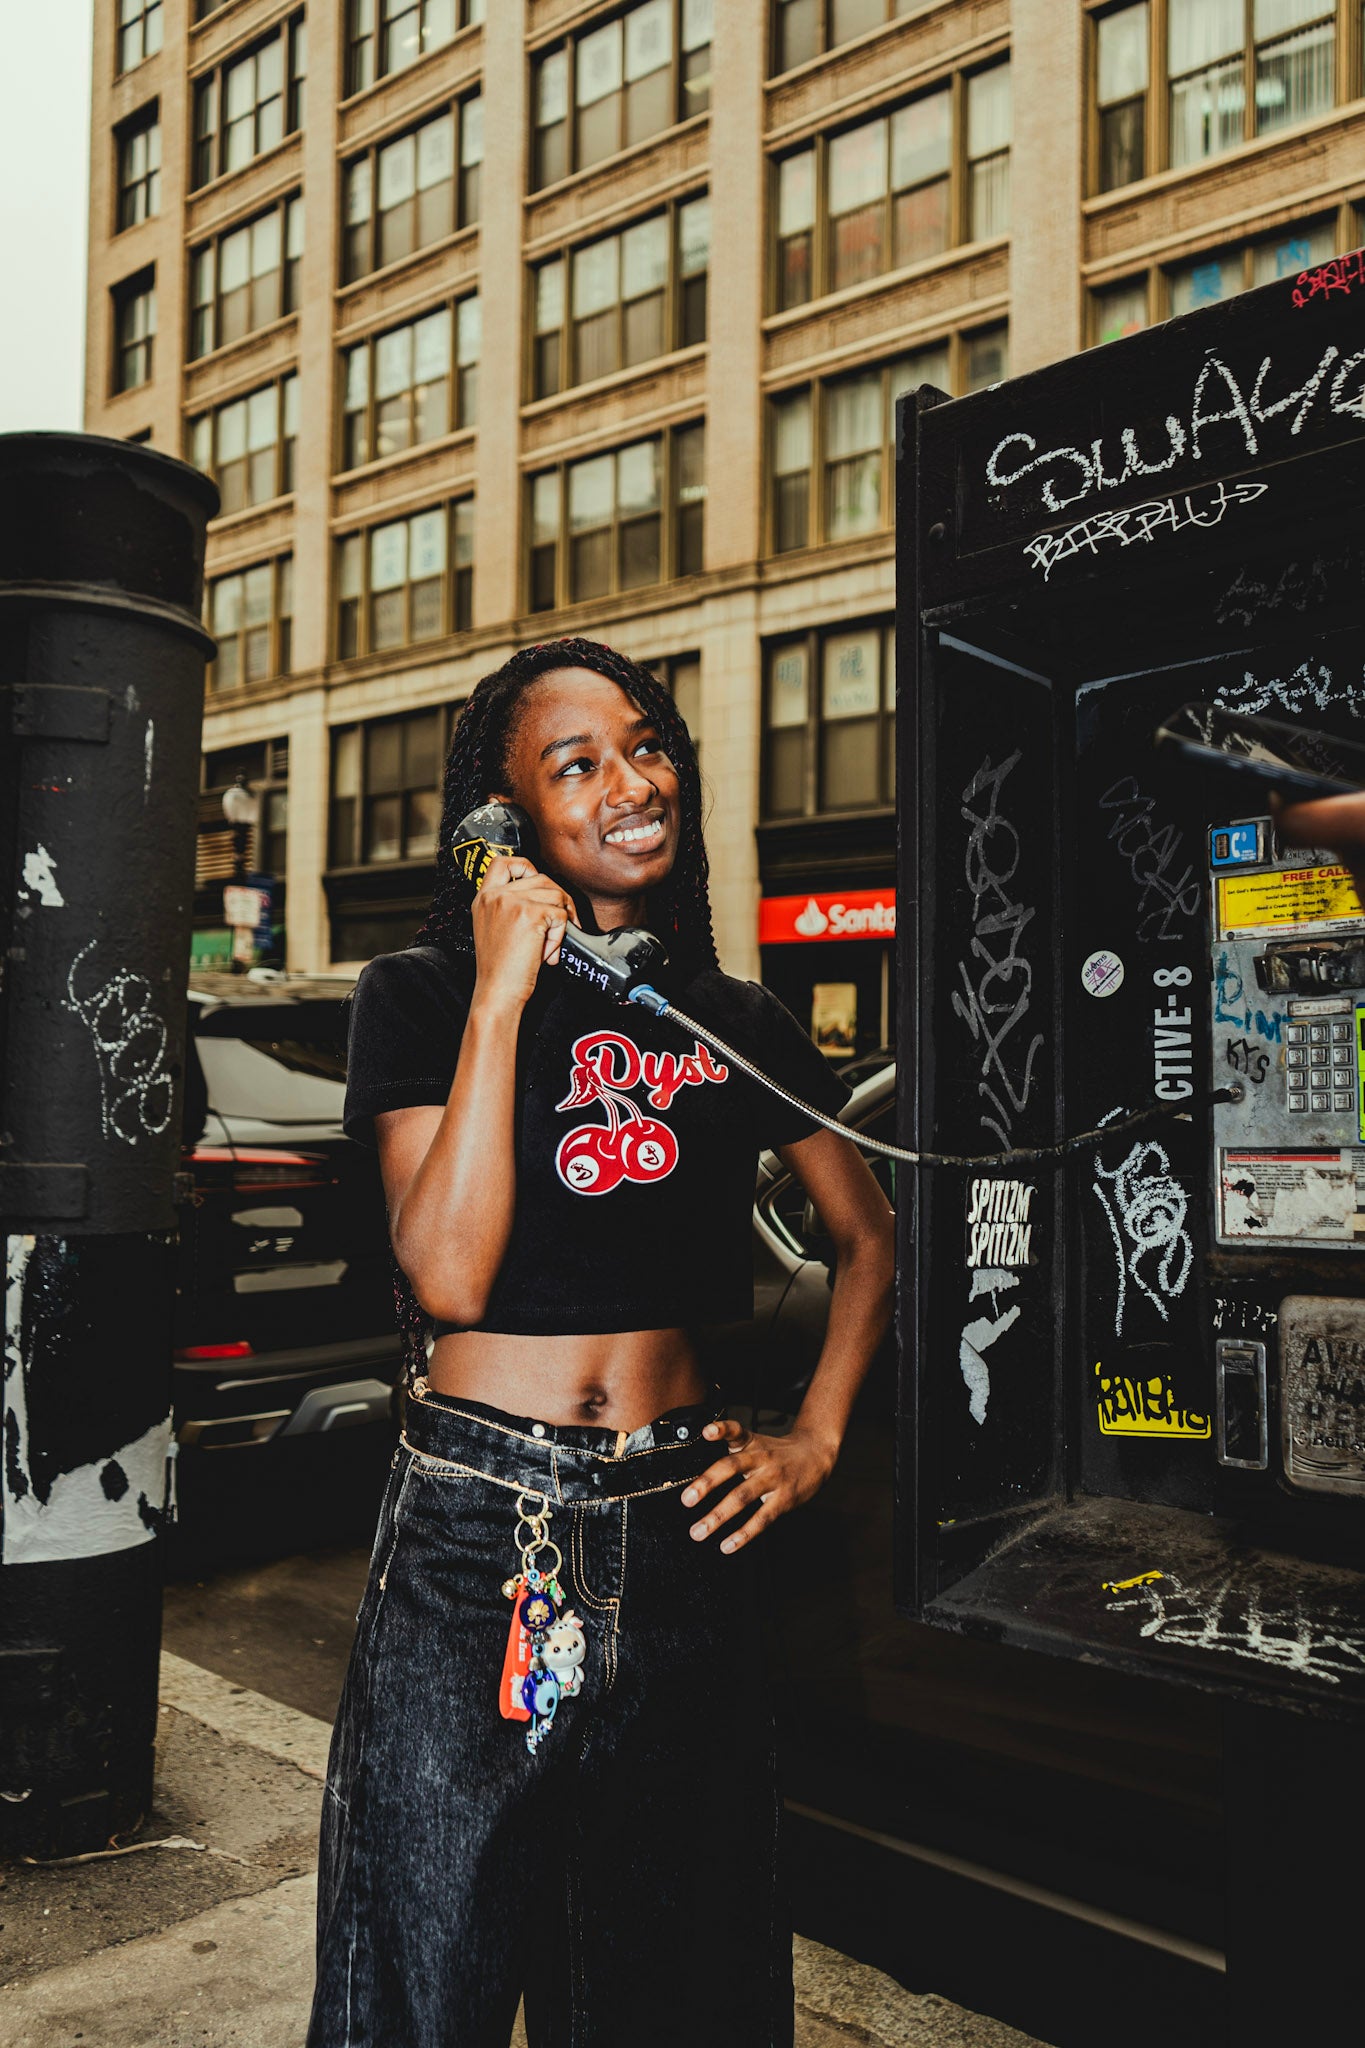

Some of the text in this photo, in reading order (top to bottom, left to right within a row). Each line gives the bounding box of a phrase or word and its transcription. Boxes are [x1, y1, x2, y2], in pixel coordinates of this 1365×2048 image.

[1282, 870, 1314, 882] FREE
[561, 948, 610, 991] bitches
[571, 1030, 729, 1111] Dyst
[1153, 965, 1194, 1121] CTIVE-8
